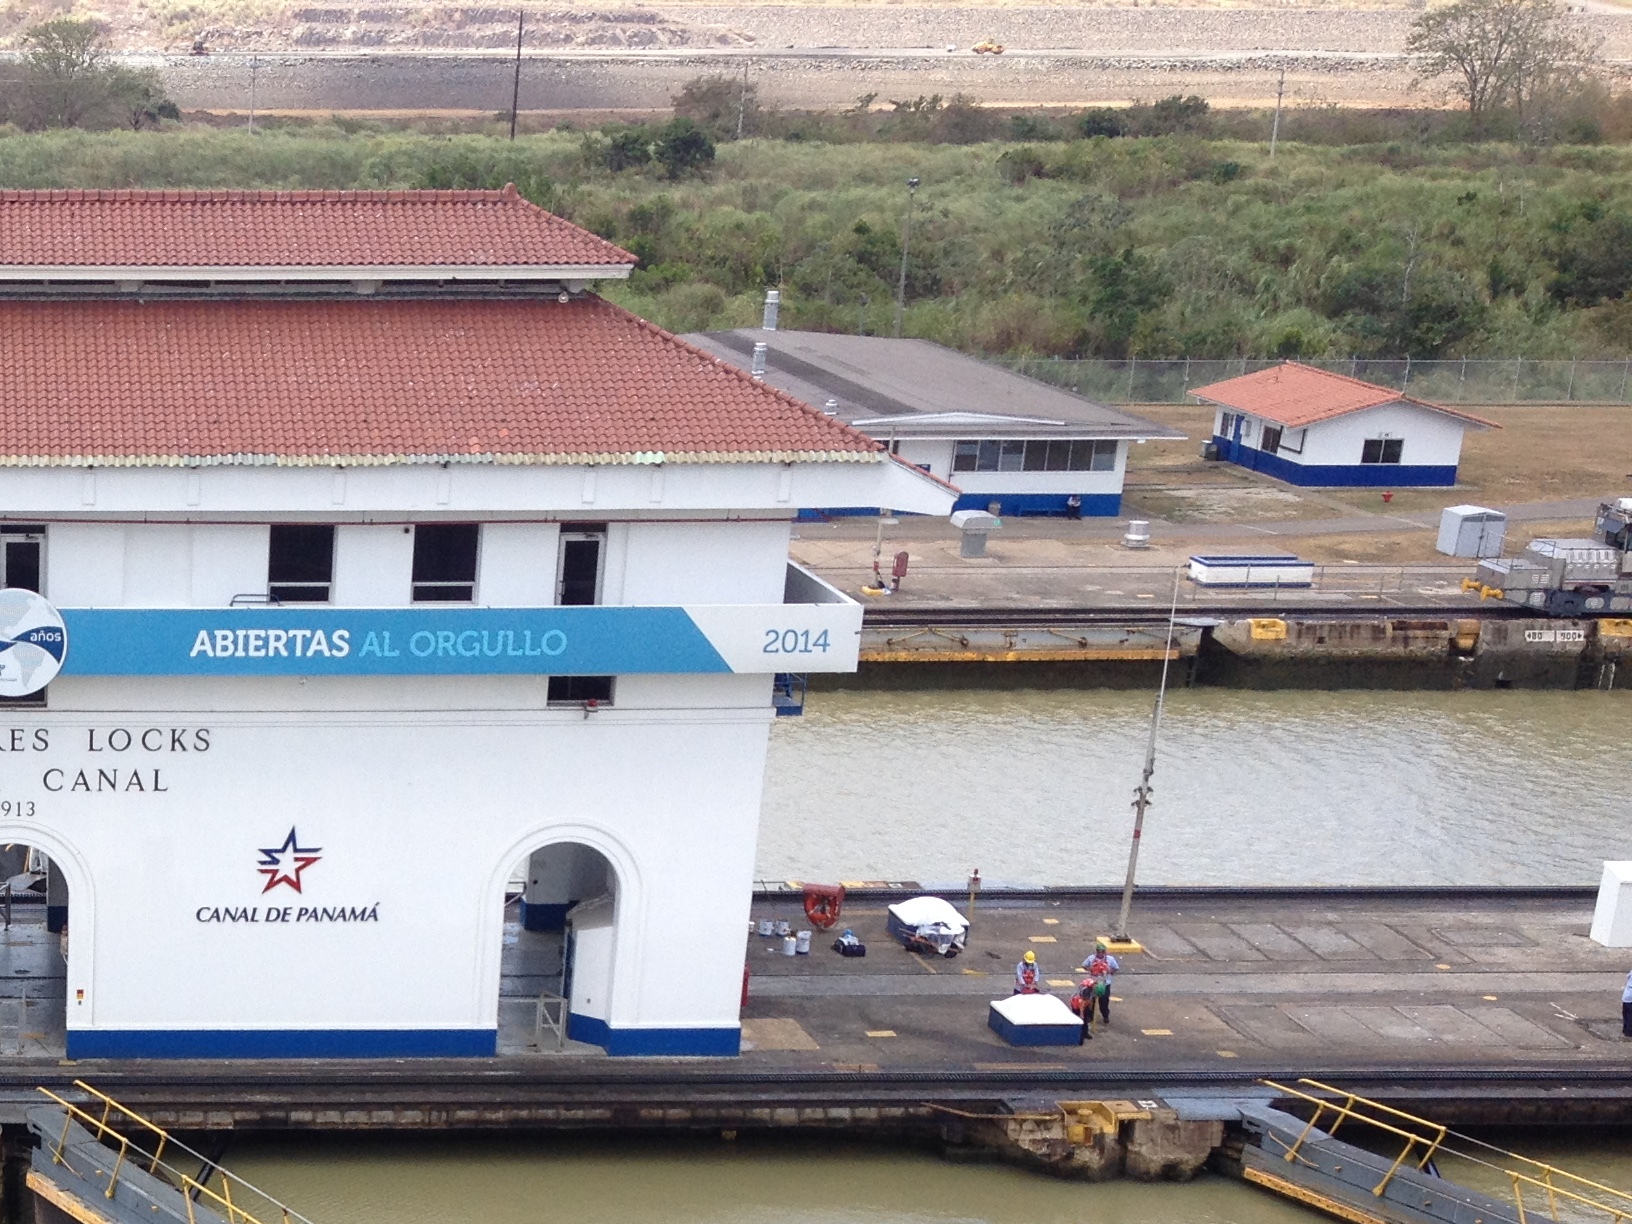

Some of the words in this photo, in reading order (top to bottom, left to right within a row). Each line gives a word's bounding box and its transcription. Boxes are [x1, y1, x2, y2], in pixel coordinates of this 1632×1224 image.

[30, 630, 62, 642] años
[189, 629, 350, 658] ABIERTAS
[358, 630, 401, 657] AL
[409, 629, 568, 658] ORGULLO
[762, 629, 831, 654] 2014
[88, 728, 210, 752] LOCKS
[43, 768, 169, 792] CANAL
[196, 906, 259, 923] CANAL
[264, 906, 293, 923] DE
[296, 902, 380, 923] PANAMÁ
